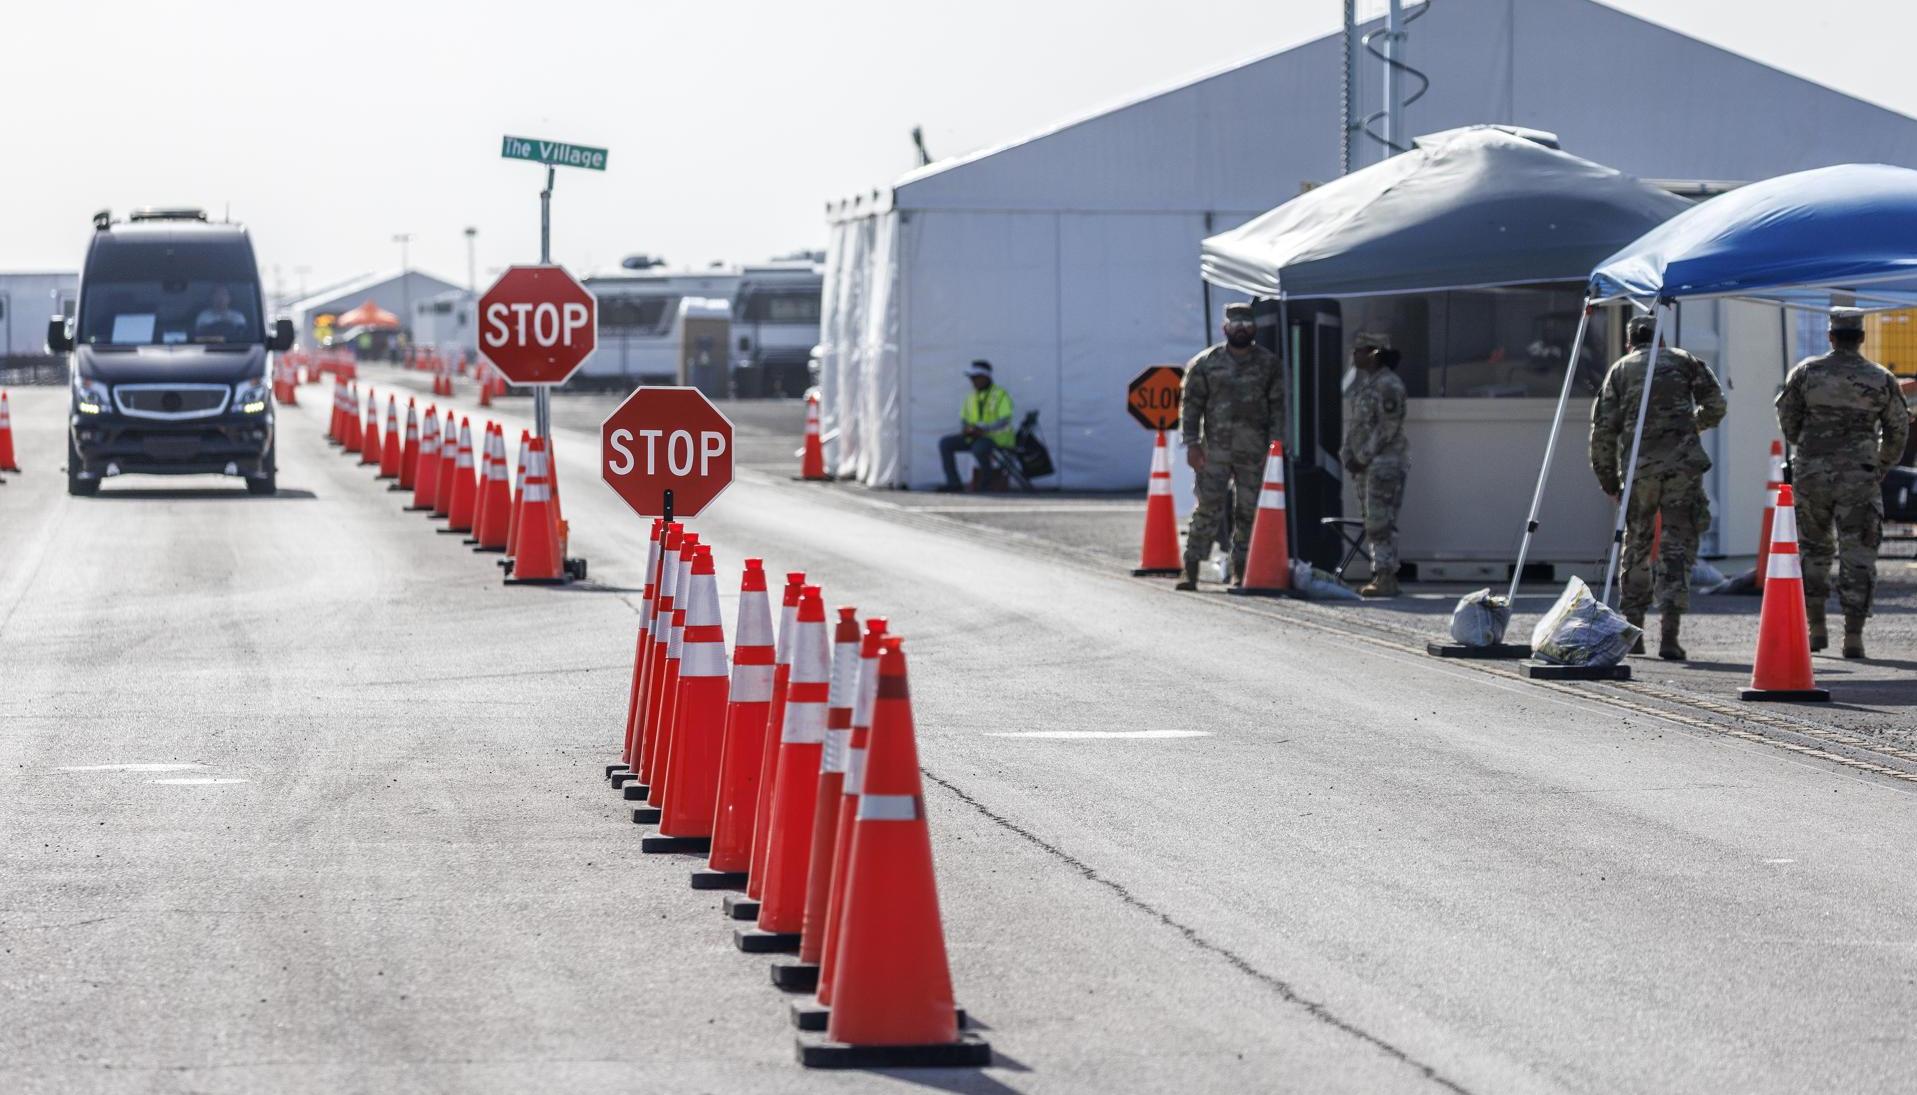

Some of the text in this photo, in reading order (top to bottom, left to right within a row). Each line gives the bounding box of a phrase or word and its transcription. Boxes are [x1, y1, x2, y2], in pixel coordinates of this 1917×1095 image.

[504, 137, 603, 168] The Village
[485, 302, 589, 347] STOP
[608, 428, 726, 477] STOP
